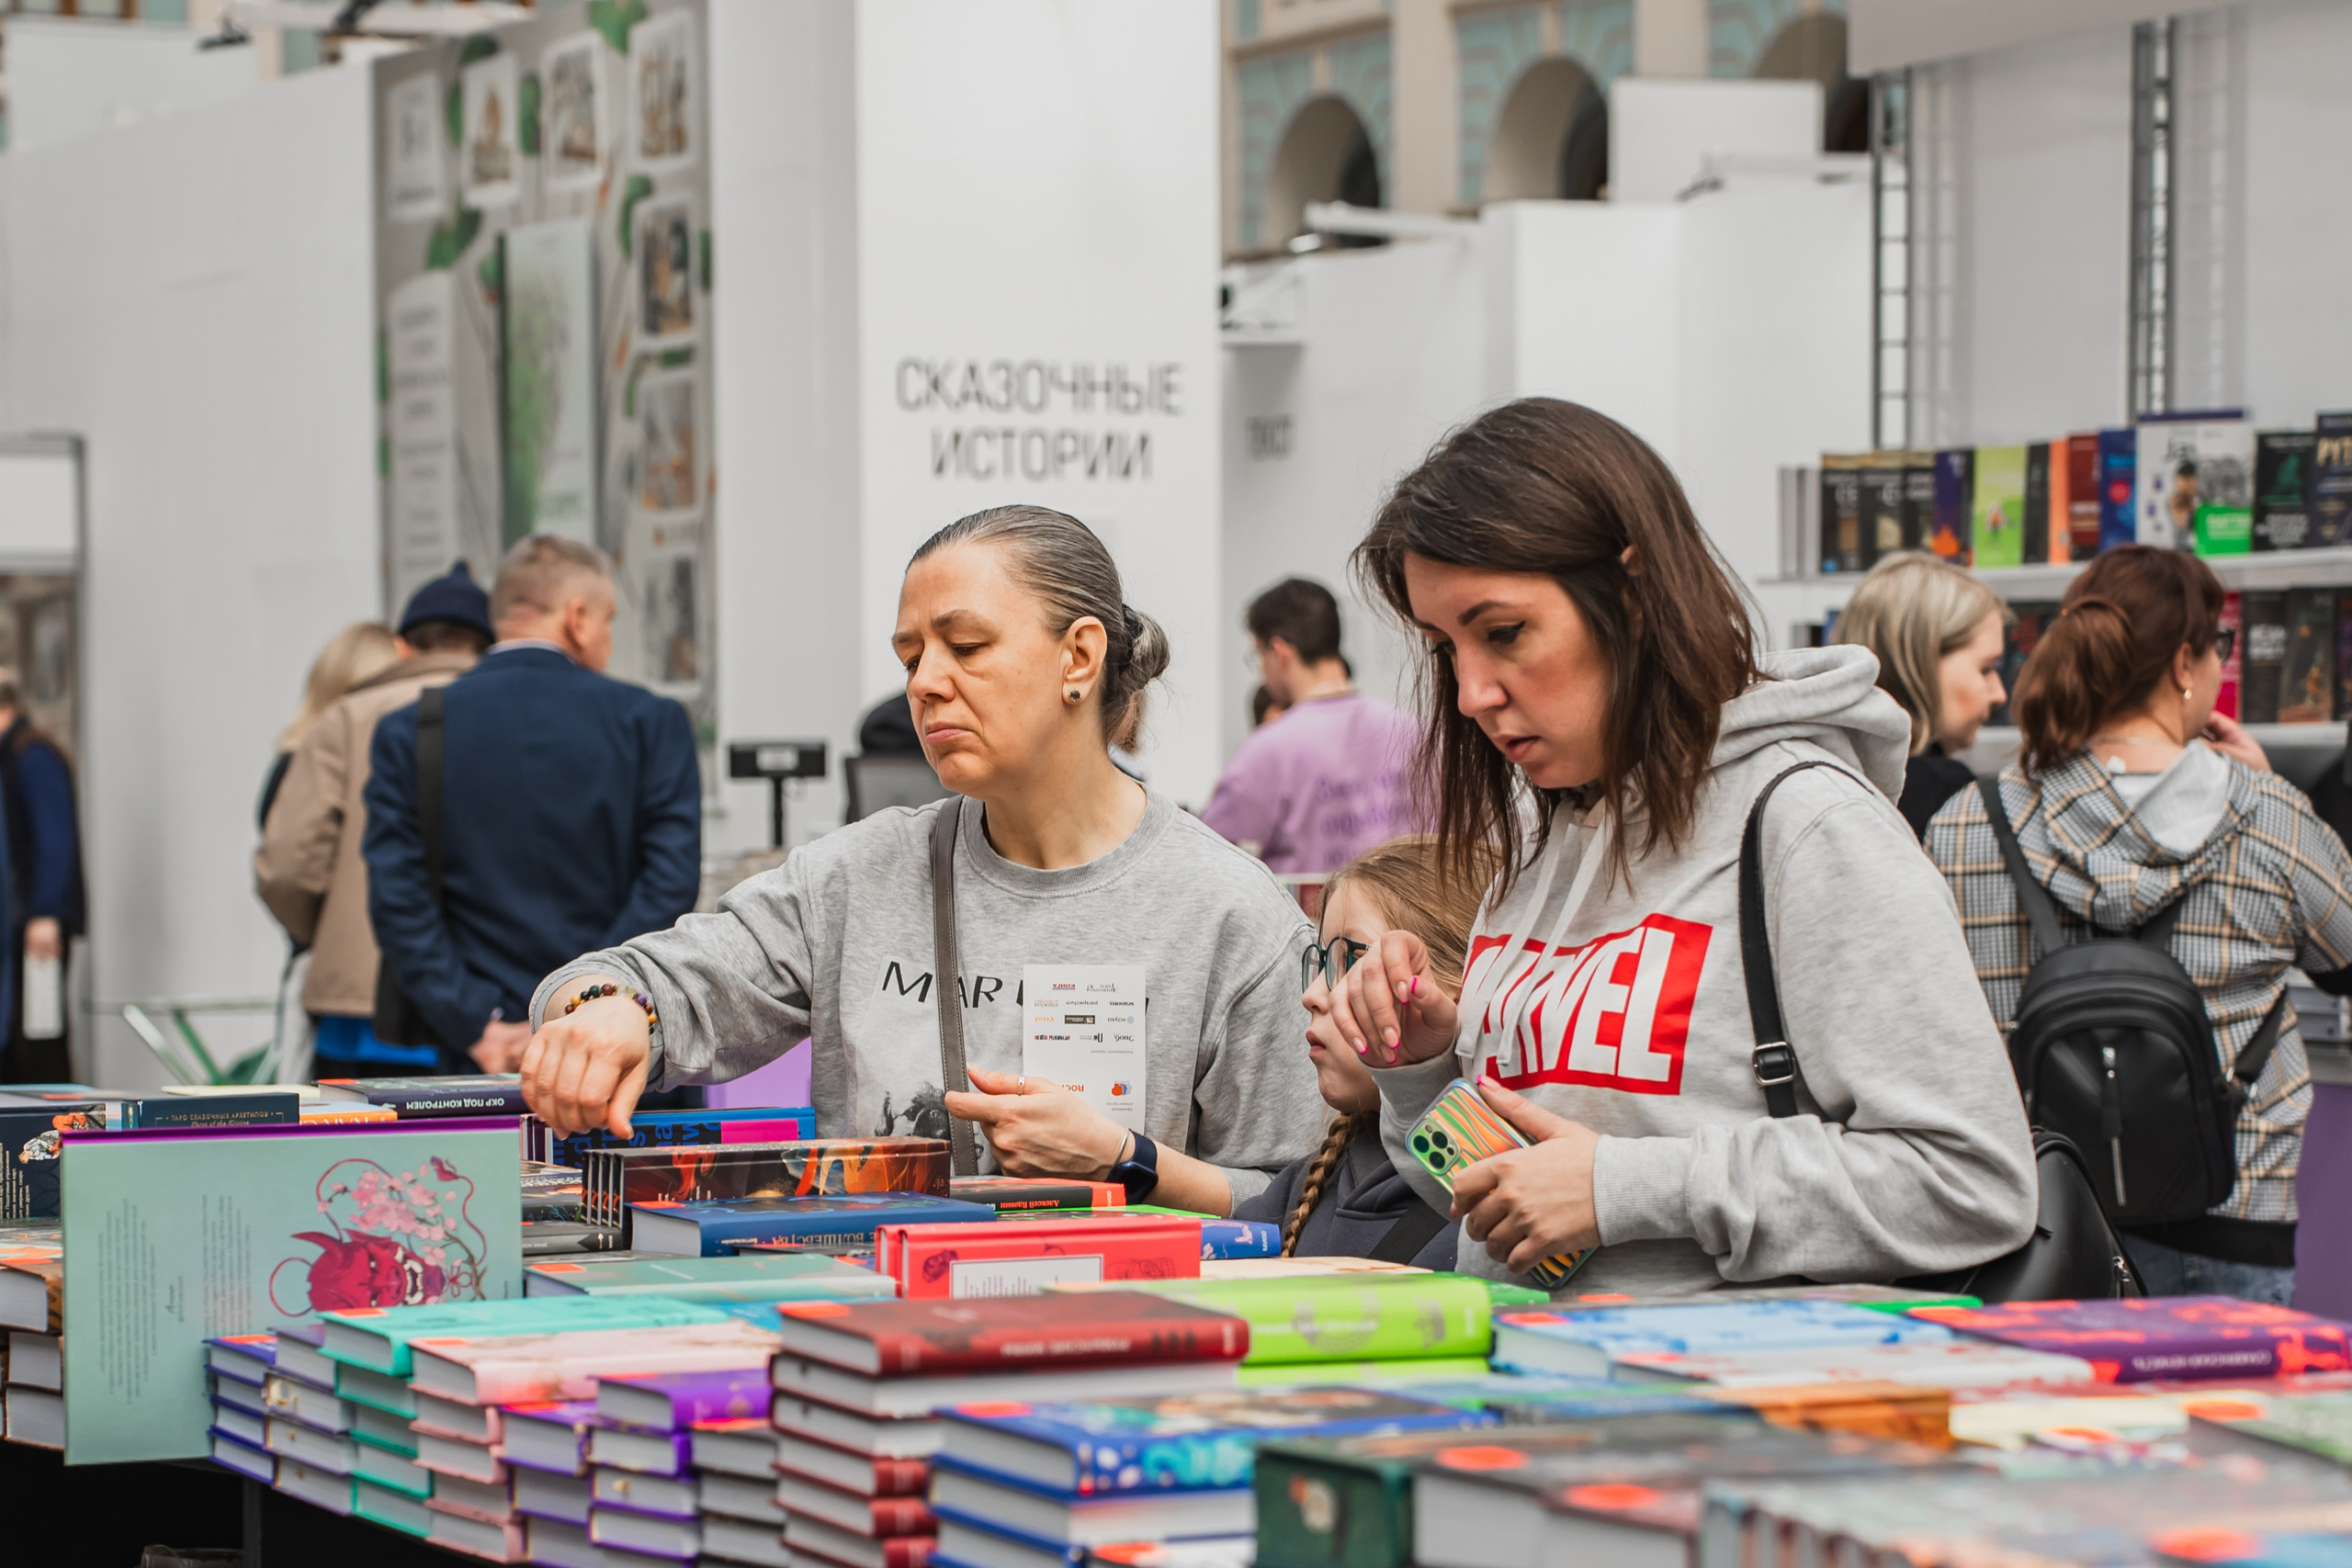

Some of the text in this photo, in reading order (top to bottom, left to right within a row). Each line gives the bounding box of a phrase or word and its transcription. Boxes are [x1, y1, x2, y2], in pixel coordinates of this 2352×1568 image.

[896, 356, 1184, 415] СКАЗОЧНЫЕ
[931, 426, 1154, 482] ИСТОРИИ
[406, 1098, 504, 1111] ОКР ПОД КОНТРОЛЕМ
[189, 1112, 230, 1121] СКАЗОЧНЫХ
[1000, 1201, 1027, 1210] Вдовин
[1029, 1199, 1059, 1208] Алексей
